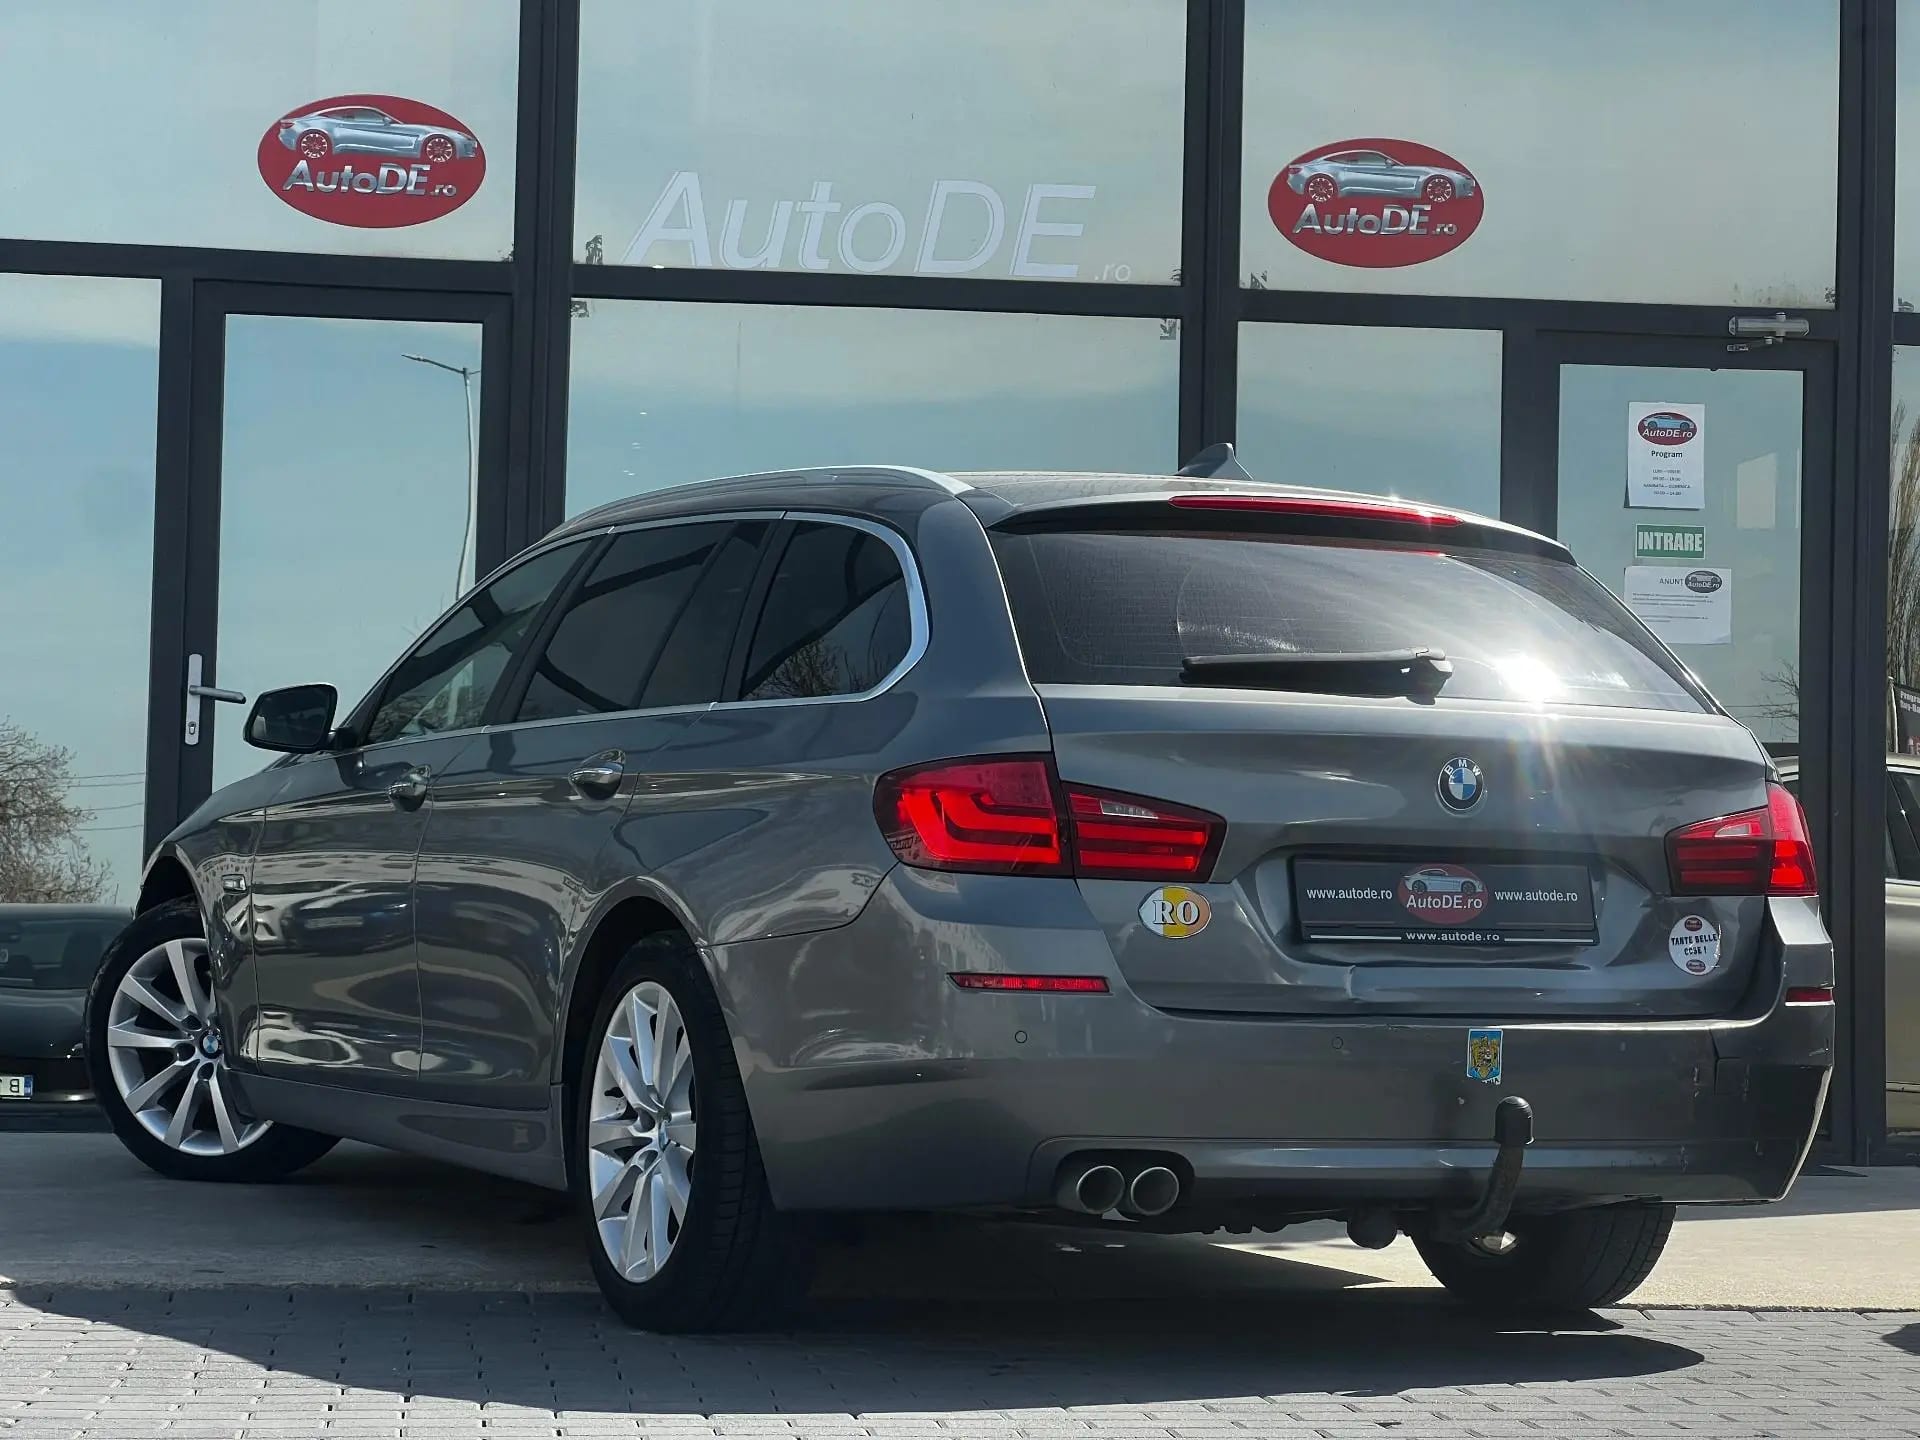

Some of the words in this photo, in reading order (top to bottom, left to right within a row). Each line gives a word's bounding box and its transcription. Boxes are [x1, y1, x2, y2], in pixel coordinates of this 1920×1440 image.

[1642, 428, 1693, 438] AutoDE.ro
[1651, 450, 1683, 458] Program
[1638, 531, 1703, 552] INTRARE
[1444, 759, 1481, 776] BMW
[1306, 887, 1393, 900] www.autode.ro
[1494, 889, 1578, 902] www.autode.ro
[1406, 894, 1483, 910] AutoDE.ro
[1153, 900, 1199, 925] RO
[1406, 931, 1500, 942] www.autode.ro
